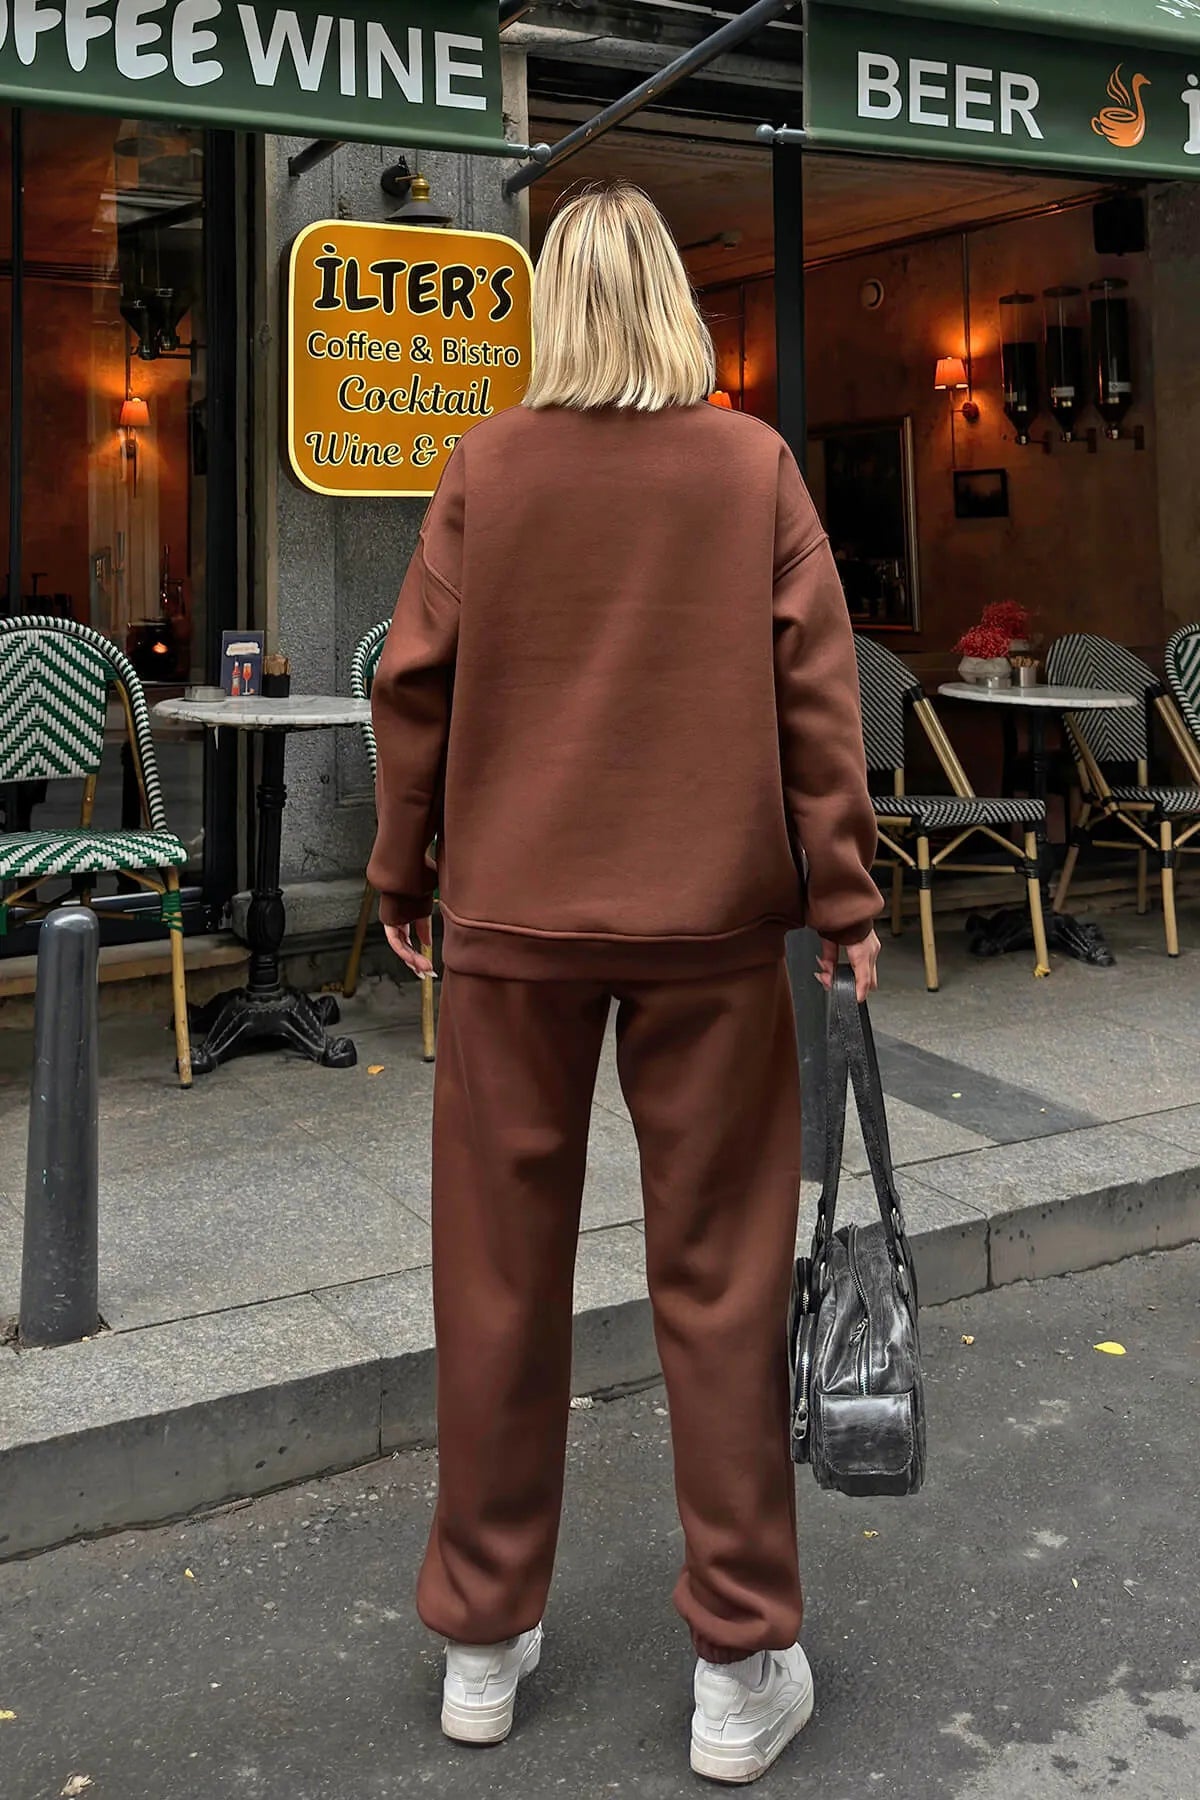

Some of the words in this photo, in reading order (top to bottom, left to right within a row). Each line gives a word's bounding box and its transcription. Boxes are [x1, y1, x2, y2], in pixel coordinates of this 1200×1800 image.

[0, 0, 224, 87] FFEE
[238, 4, 487, 111] WINE
[858, 51, 1044, 139] BEER
[307, 331, 401, 362] Coffee
[410, 335, 433, 364] &
[442, 337, 520, 367] Bistro
[338, 373, 493, 416] Cocktail
[305, 431, 403, 467] Wine
[410, 434, 438, 467] &
